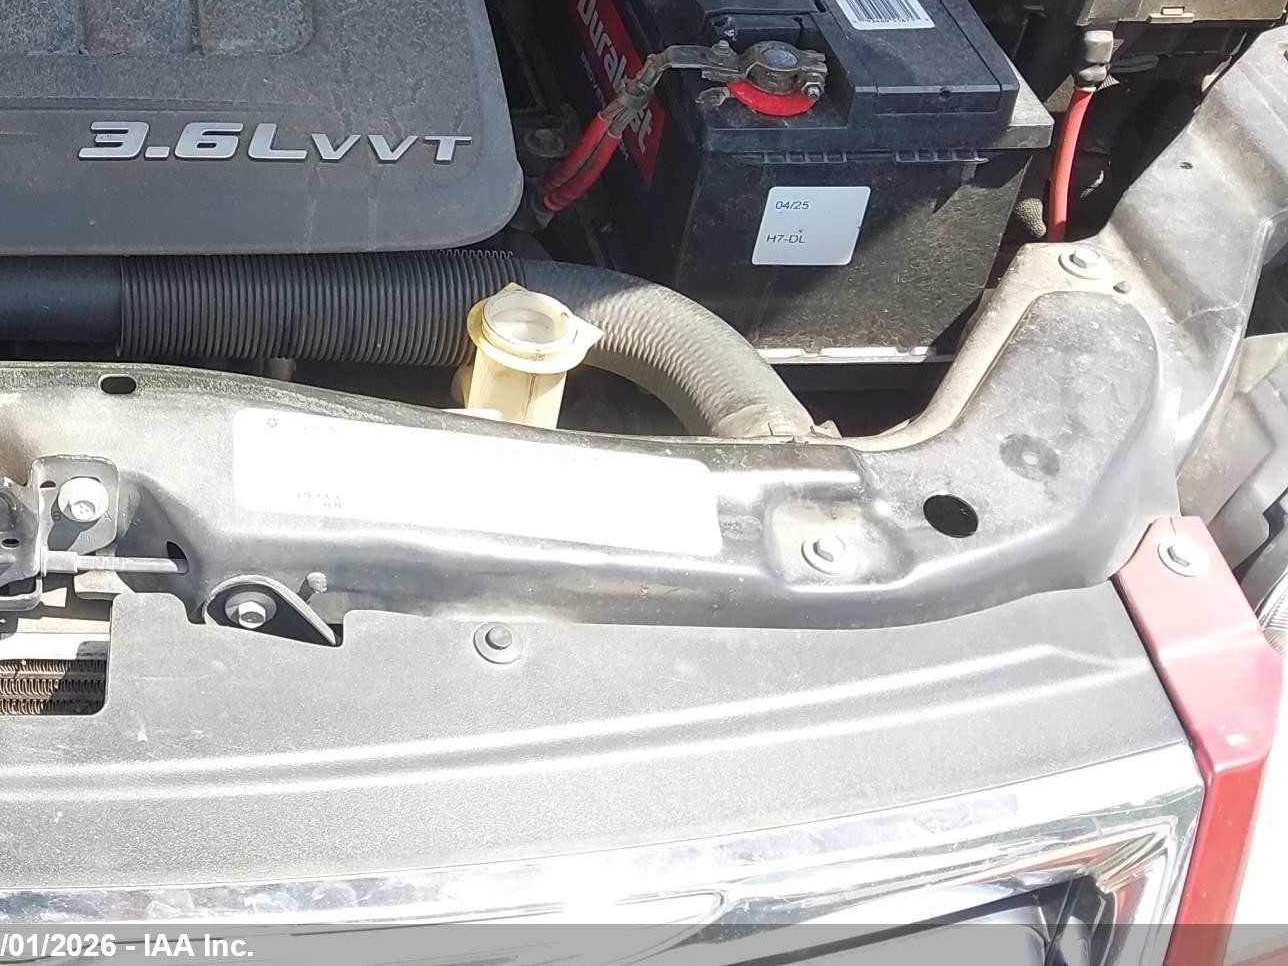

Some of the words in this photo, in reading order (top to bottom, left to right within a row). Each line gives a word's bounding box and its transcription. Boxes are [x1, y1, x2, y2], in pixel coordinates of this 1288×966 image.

[78, 121, 308, 161] 3.6L
[312, 133, 473, 163] VVT
[775, 200, 810, 211] 04/25
[766, 234, 807, 244] H7-DL
